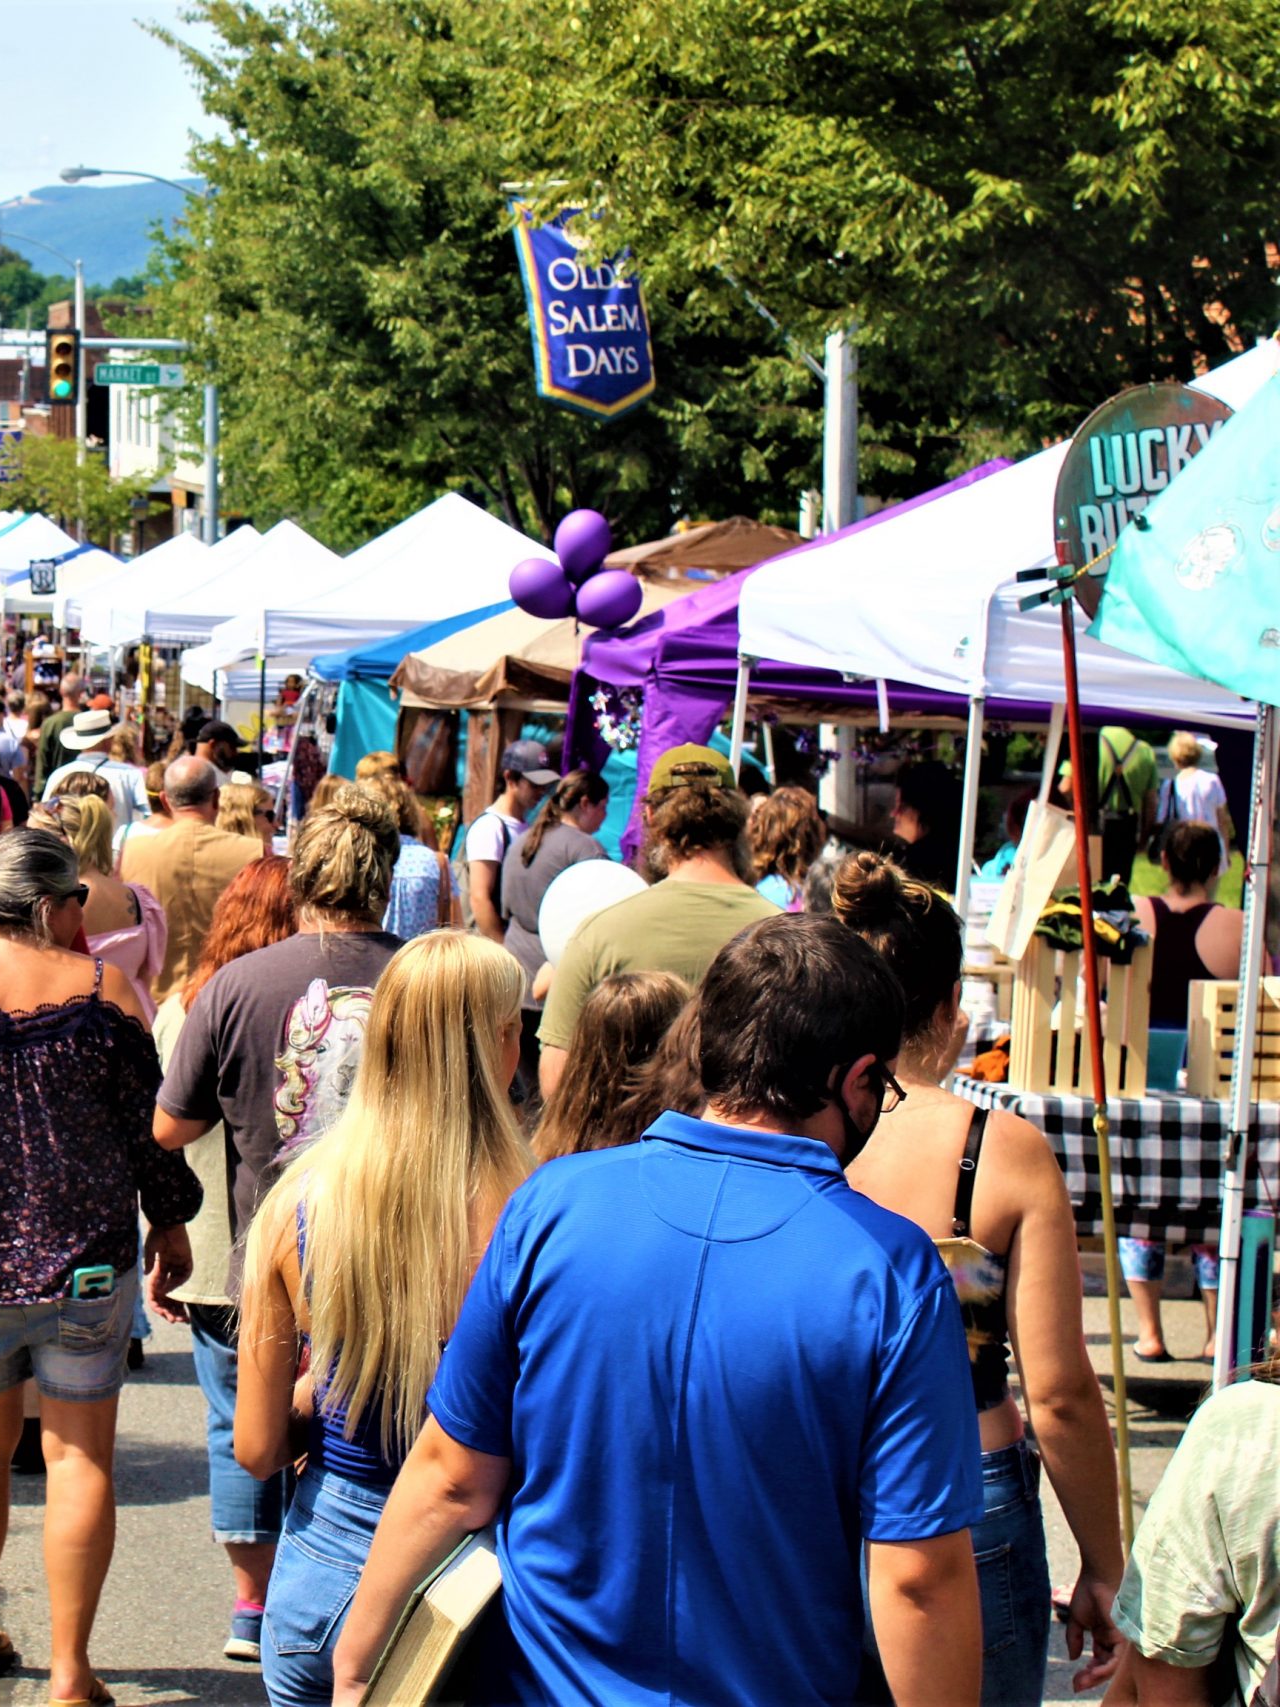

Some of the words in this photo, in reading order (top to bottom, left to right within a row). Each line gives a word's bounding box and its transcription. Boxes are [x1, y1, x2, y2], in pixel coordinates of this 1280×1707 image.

[547, 300, 641, 336] SALEM
[99, 367, 140, 381] MARKET
[566, 344, 639, 377] DAYS
[1079, 495, 1157, 577] BU
